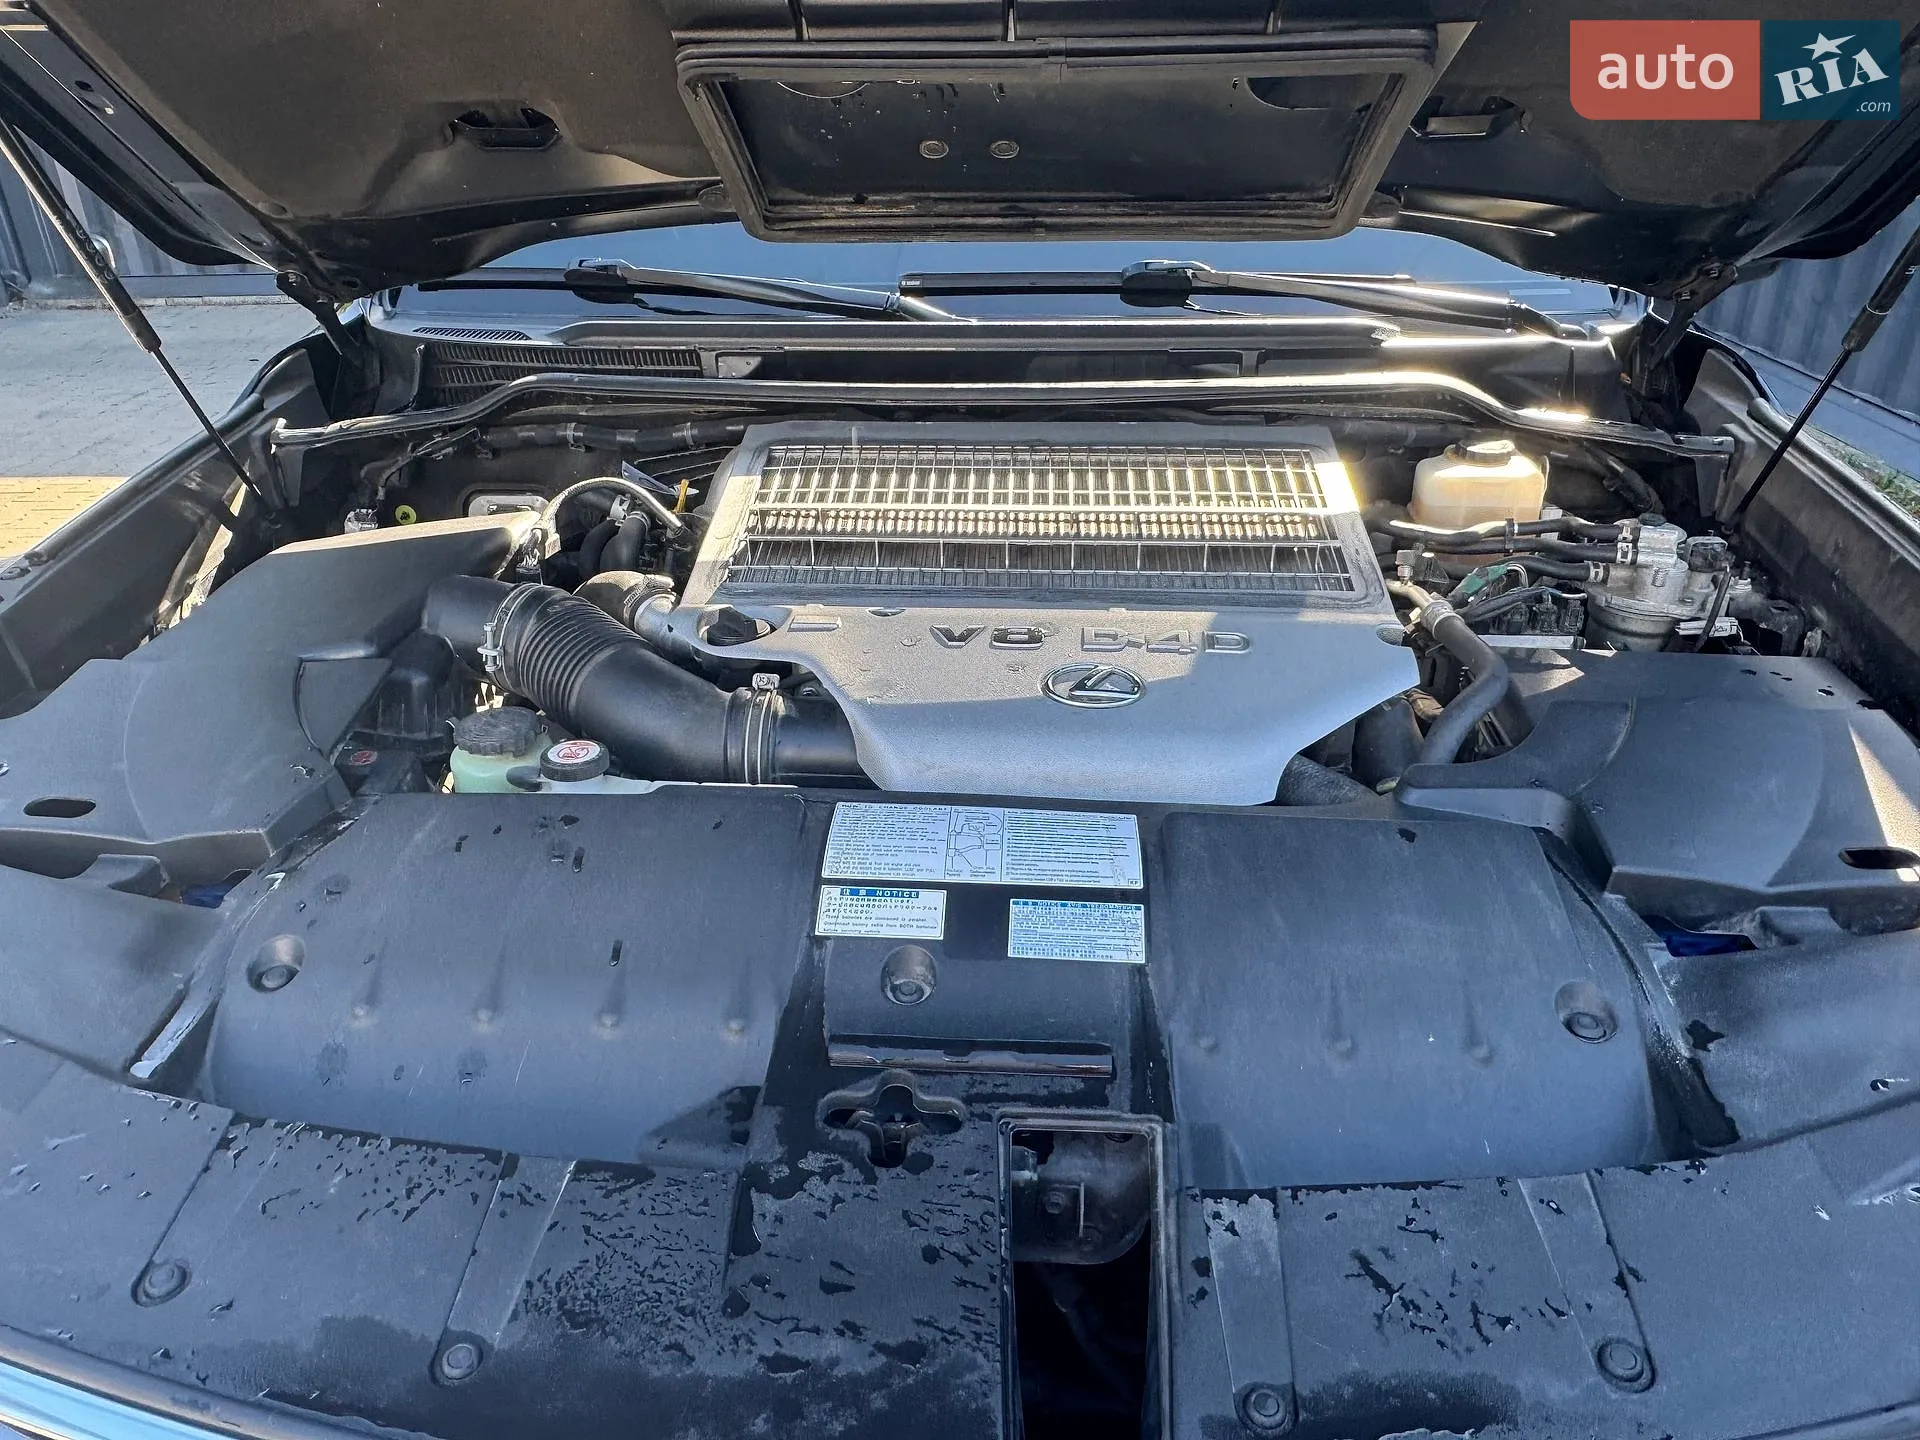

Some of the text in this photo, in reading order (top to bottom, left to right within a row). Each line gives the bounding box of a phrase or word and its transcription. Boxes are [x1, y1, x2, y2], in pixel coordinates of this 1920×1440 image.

[929, 625, 1251, 654] V8 D-4D
[876, 889, 918, 899] NOTICE
